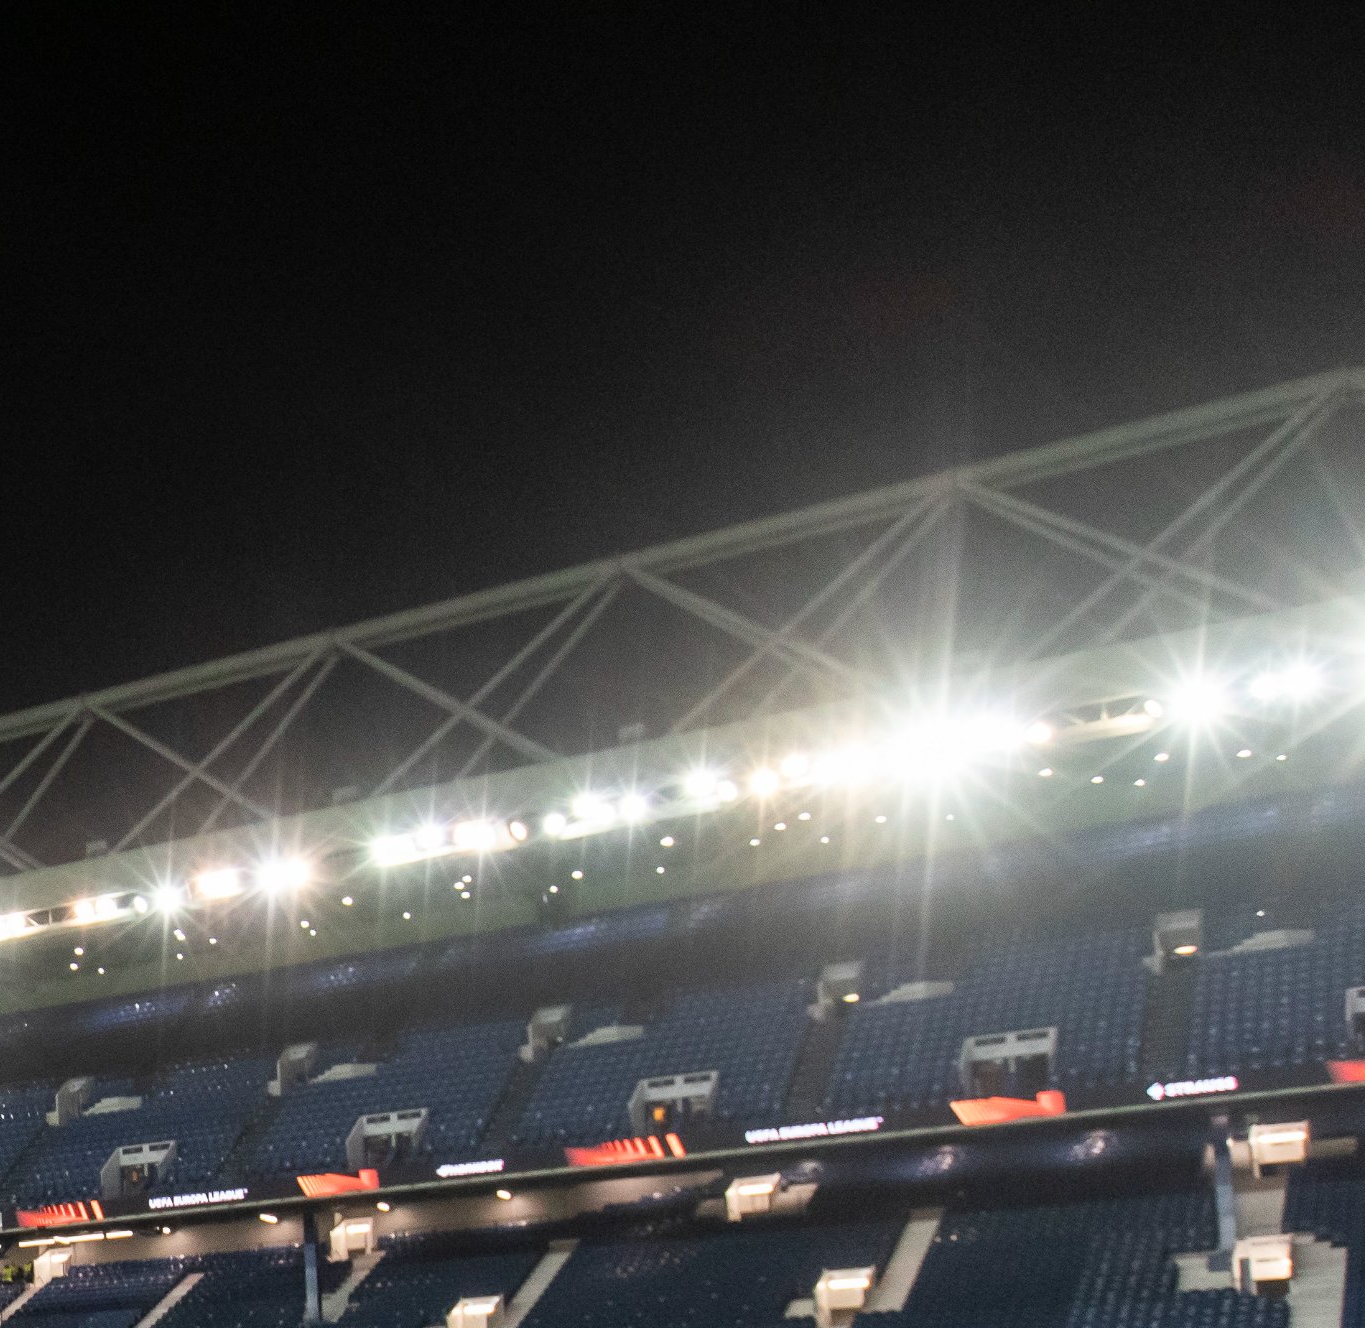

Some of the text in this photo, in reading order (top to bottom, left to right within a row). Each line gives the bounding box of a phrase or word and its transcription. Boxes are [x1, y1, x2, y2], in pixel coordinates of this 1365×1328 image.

[148, 1188, 245, 1210] UEFA EUROPA LEAGUE
